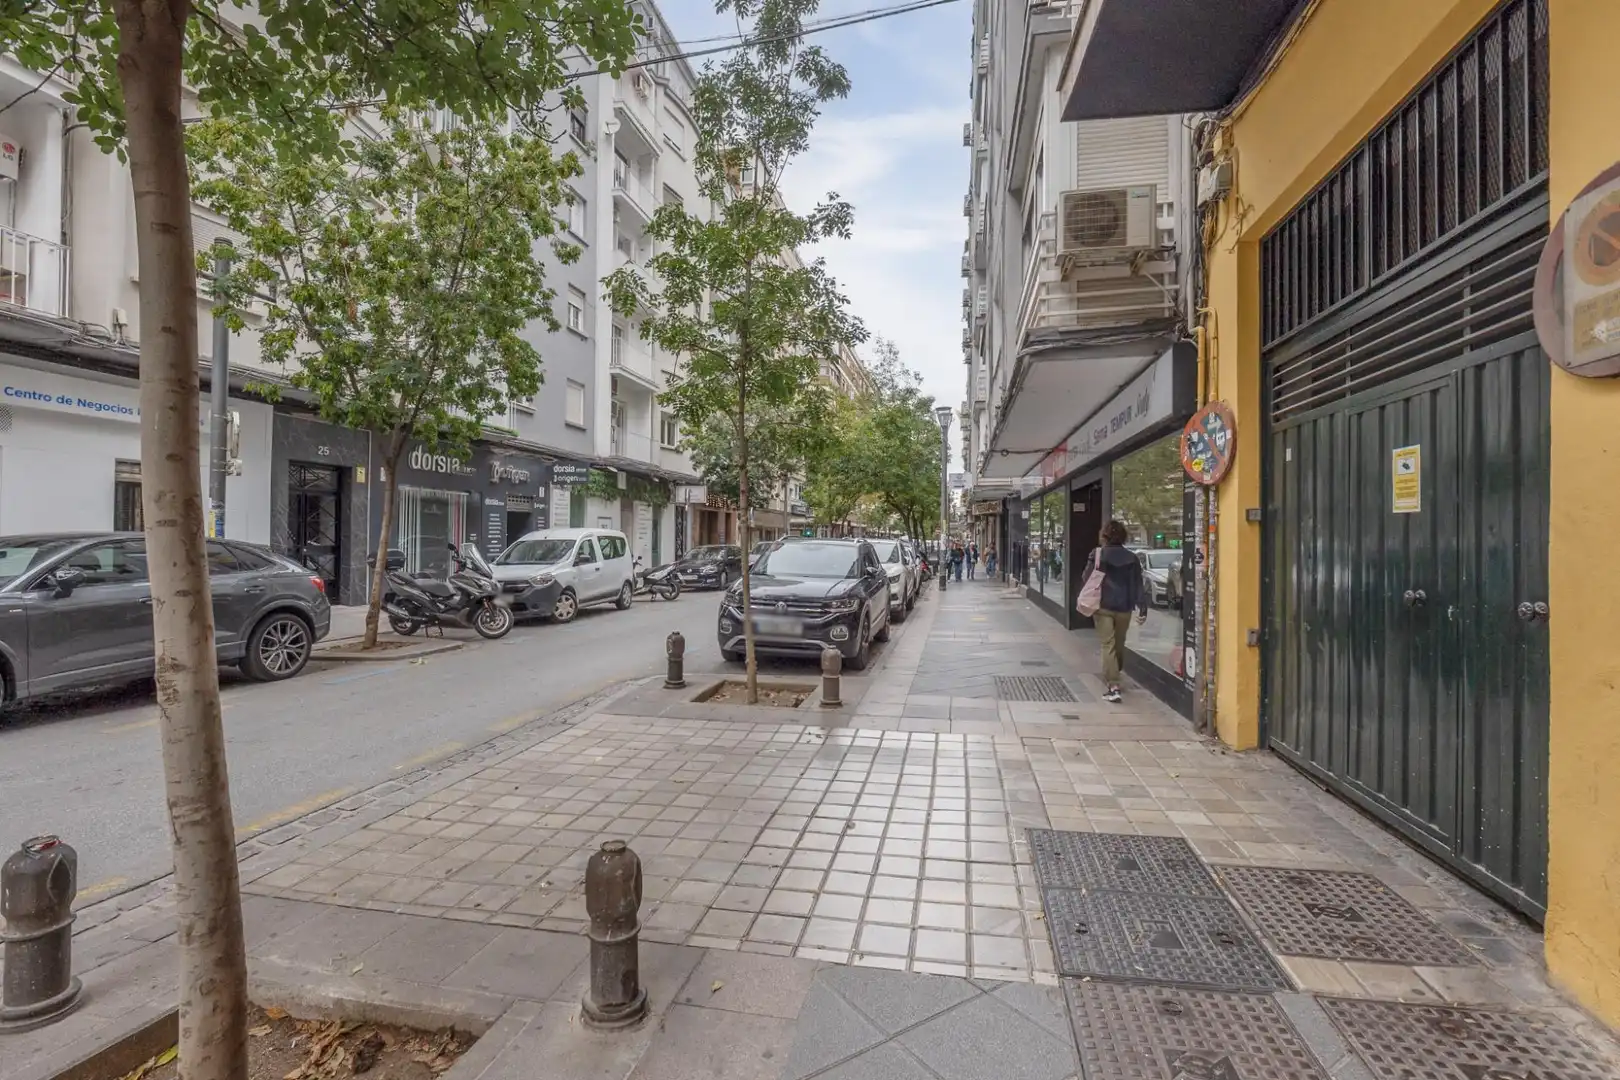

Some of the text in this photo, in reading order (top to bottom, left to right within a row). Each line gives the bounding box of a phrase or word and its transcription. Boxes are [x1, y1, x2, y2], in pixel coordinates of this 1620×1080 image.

[4, 386, 134, 416] Centro de Negocios
[317, 445, 330, 456] 25
[410, 444, 460, 473] dorsia
[553, 463, 575, 473] dorsia
